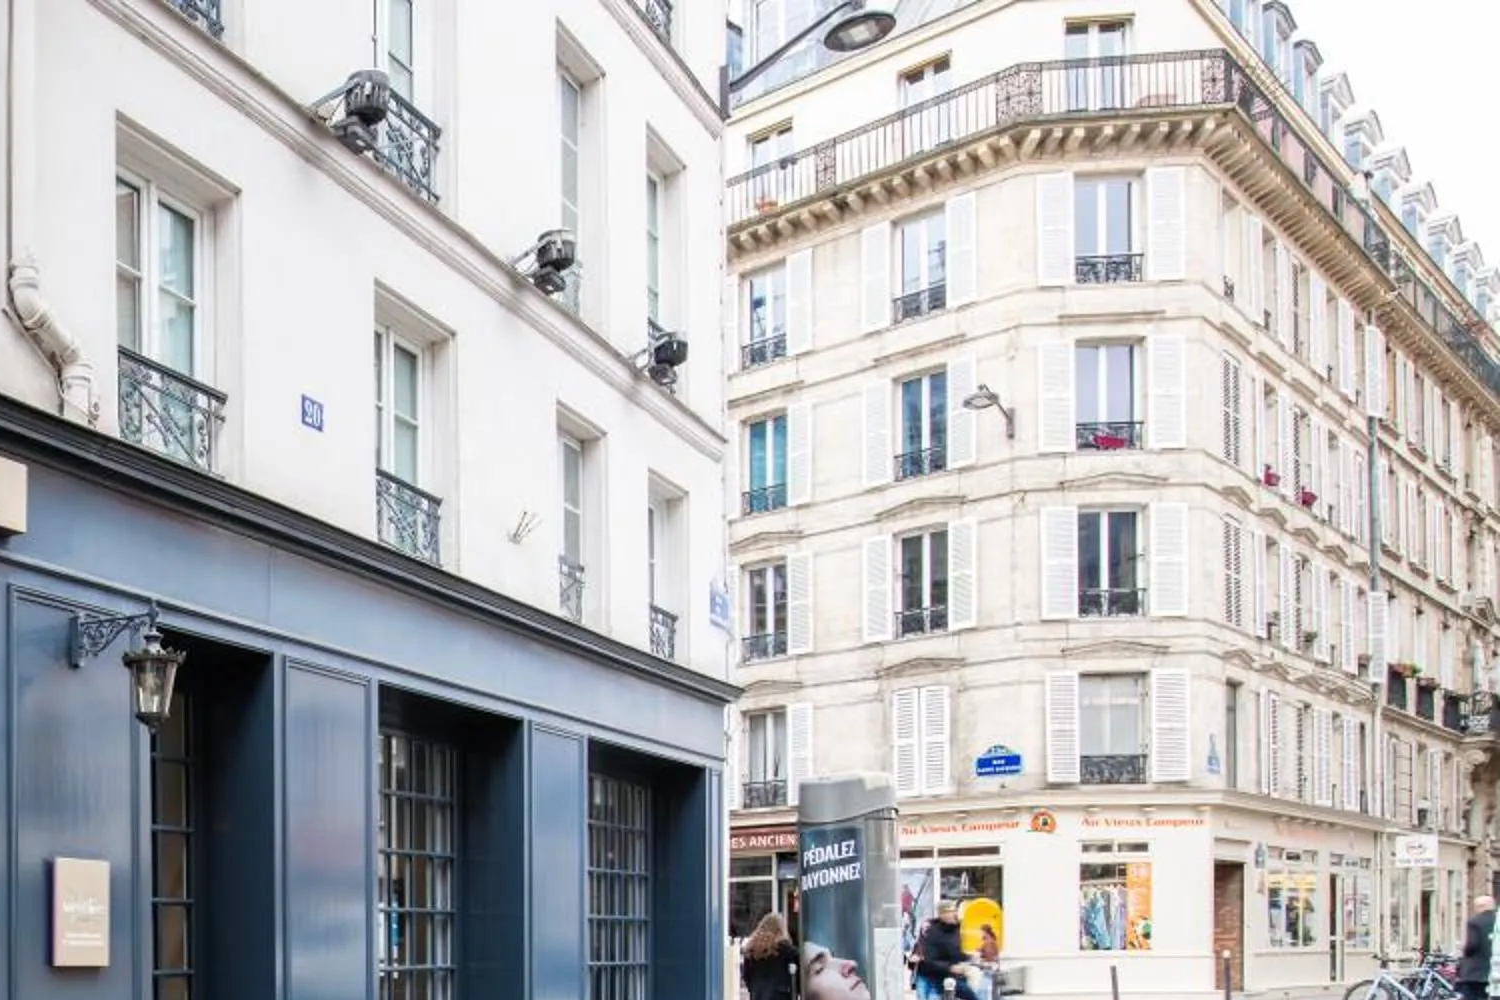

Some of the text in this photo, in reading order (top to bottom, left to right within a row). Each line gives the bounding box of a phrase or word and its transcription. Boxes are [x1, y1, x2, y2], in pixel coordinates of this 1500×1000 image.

[304, 399, 321, 427] 20
[731, 833, 797, 849] ES ANCIEN
[803, 839, 857, 868] PÉDALEZ
